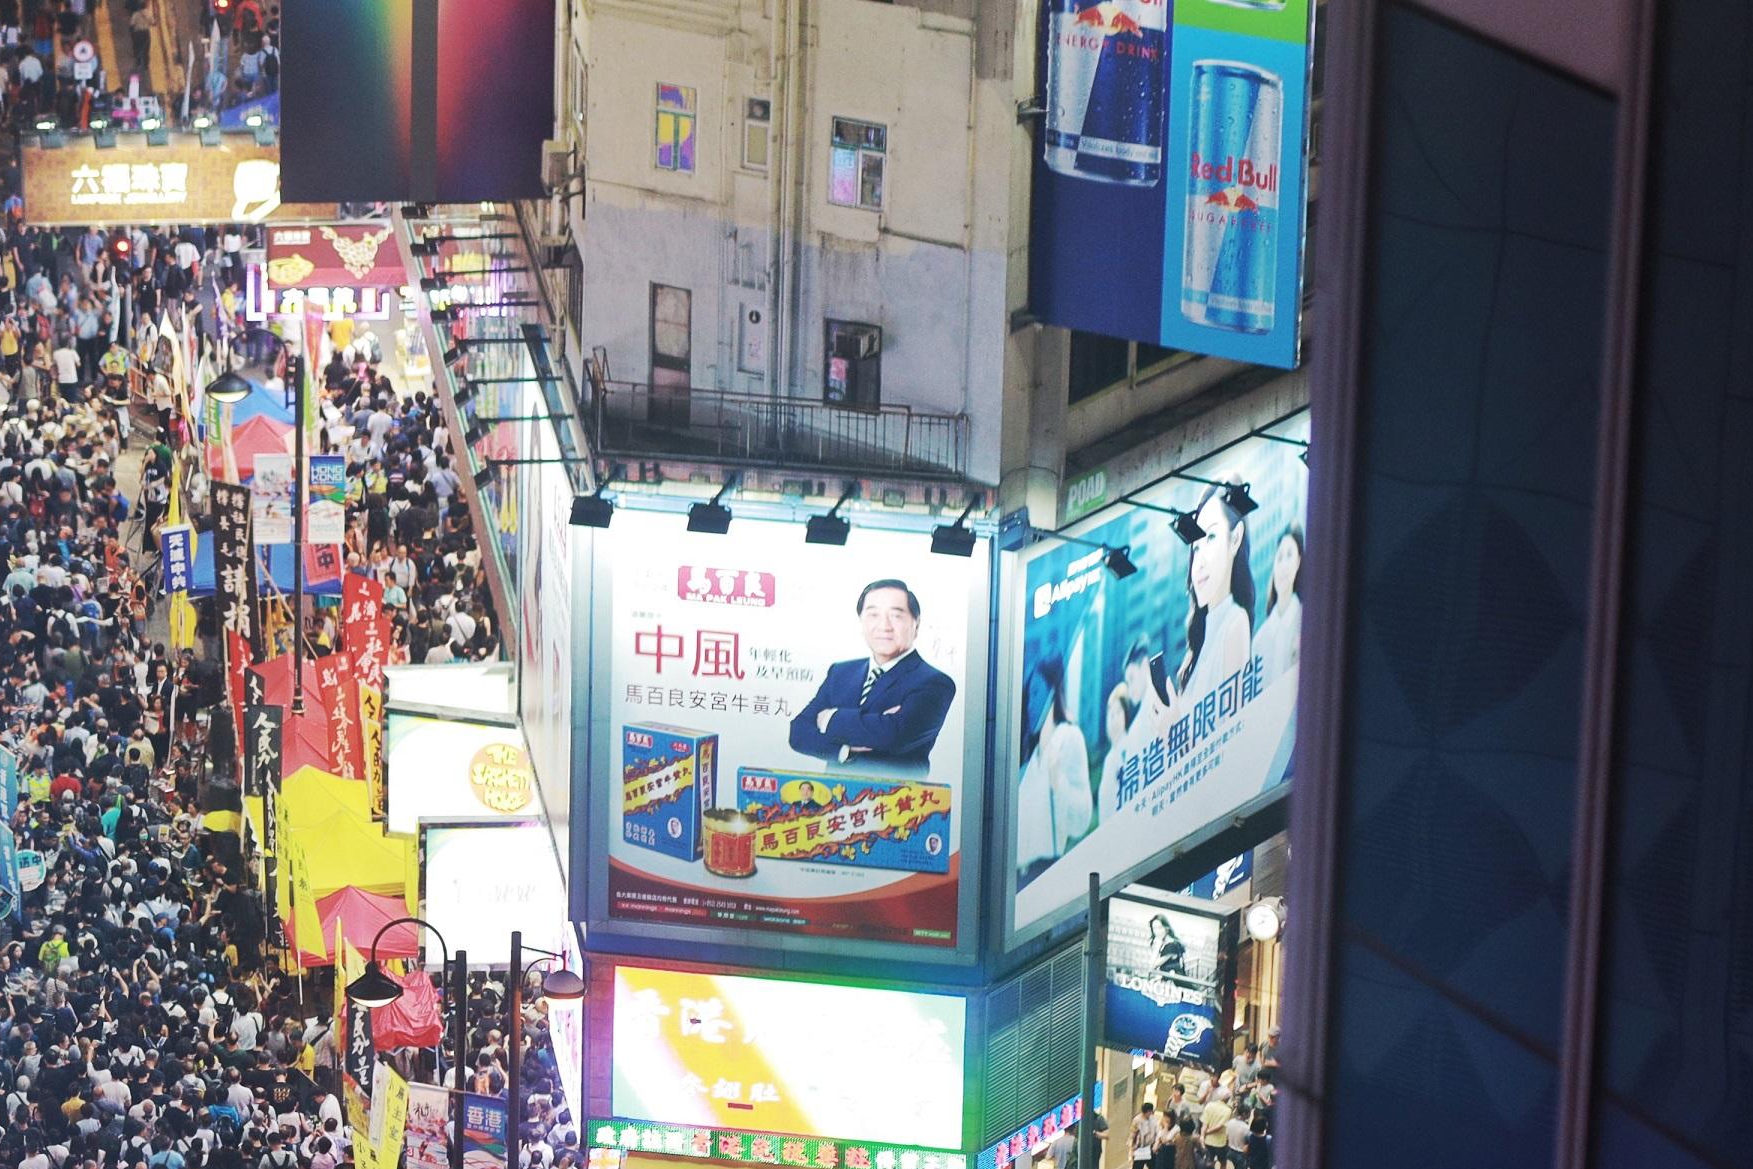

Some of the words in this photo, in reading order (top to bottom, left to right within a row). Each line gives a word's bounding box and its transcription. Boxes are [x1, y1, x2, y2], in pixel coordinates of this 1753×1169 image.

[1190, 152, 1232, 183] Red
[1238, 158, 1277, 192] Bull
[310, 465, 343, 474] HONG
[310, 473, 343, 483] KONG
[1067, 472, 1104, 511] POAD
[168, 533, 187, 590] 天滅中共
[634, 623, 746, 681] 中風
[748, 646, 792, 664] 年輕化
[756, 666, 814, 683] 及早預防
[625, 684, 792, 718] 馬百良安宮牛黃丸
[486, 744, 519, 767] THE
[760, 789, 941, 852] 馬百良安宮牛黃丸
[1121, 974, 1203, 1005] LONGINES
[466, 1105, 502, 1129] 香港
